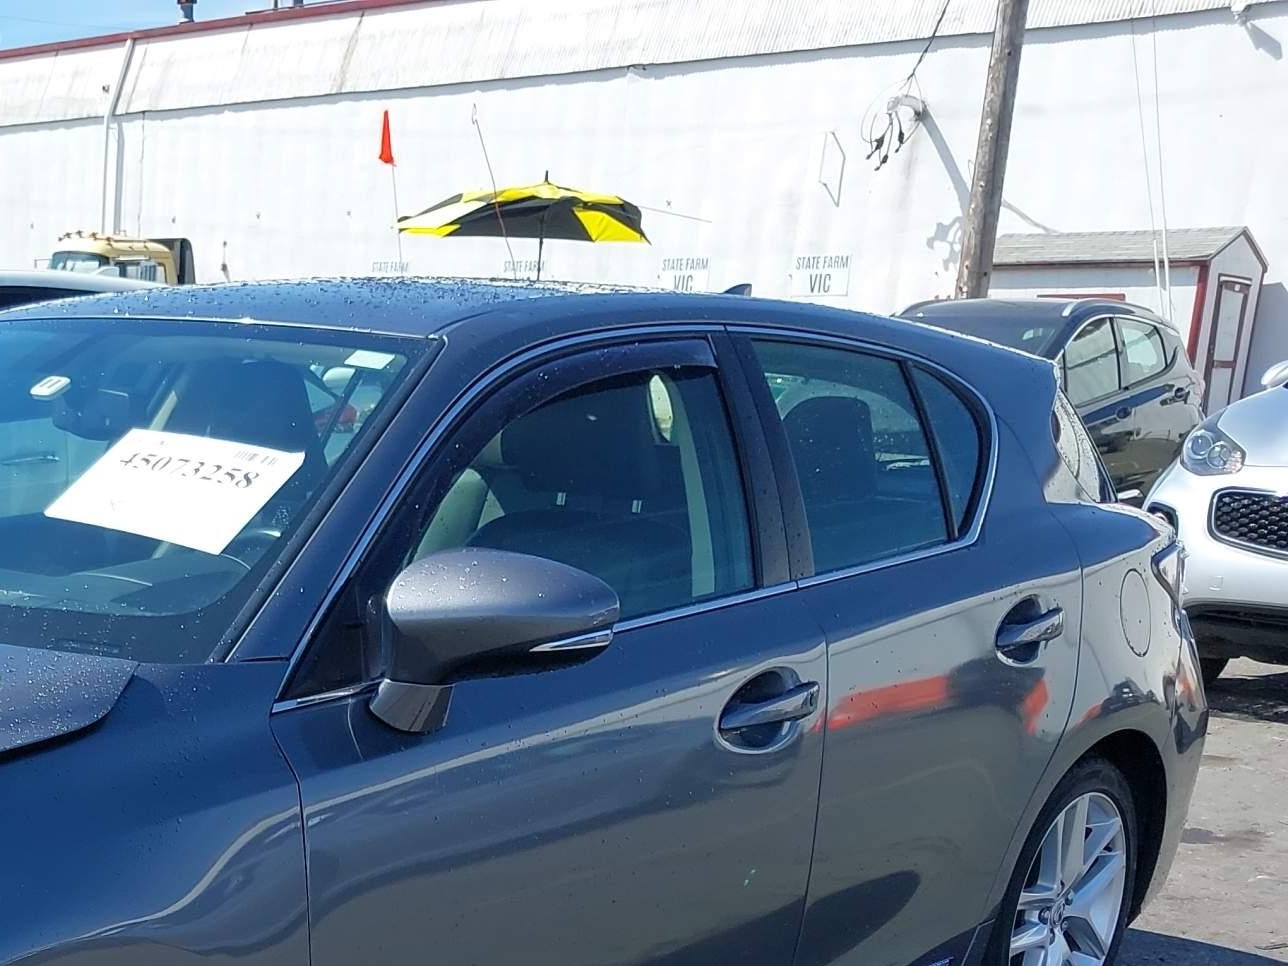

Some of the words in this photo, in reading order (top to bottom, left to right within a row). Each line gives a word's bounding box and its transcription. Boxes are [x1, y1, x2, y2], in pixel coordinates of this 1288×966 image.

[504, 260, 523, 273] STATE
[662, 257, 684, 271] STATE
[685, 257, 709, 270] FARM
[795, 256, 822, 270] STATE
[823, 255, 849, 269] FARM
[673, 274, 694, 291] VIC
[809, 274, 831, 294] VIC
[120, 452, 260, 488] 45073258
